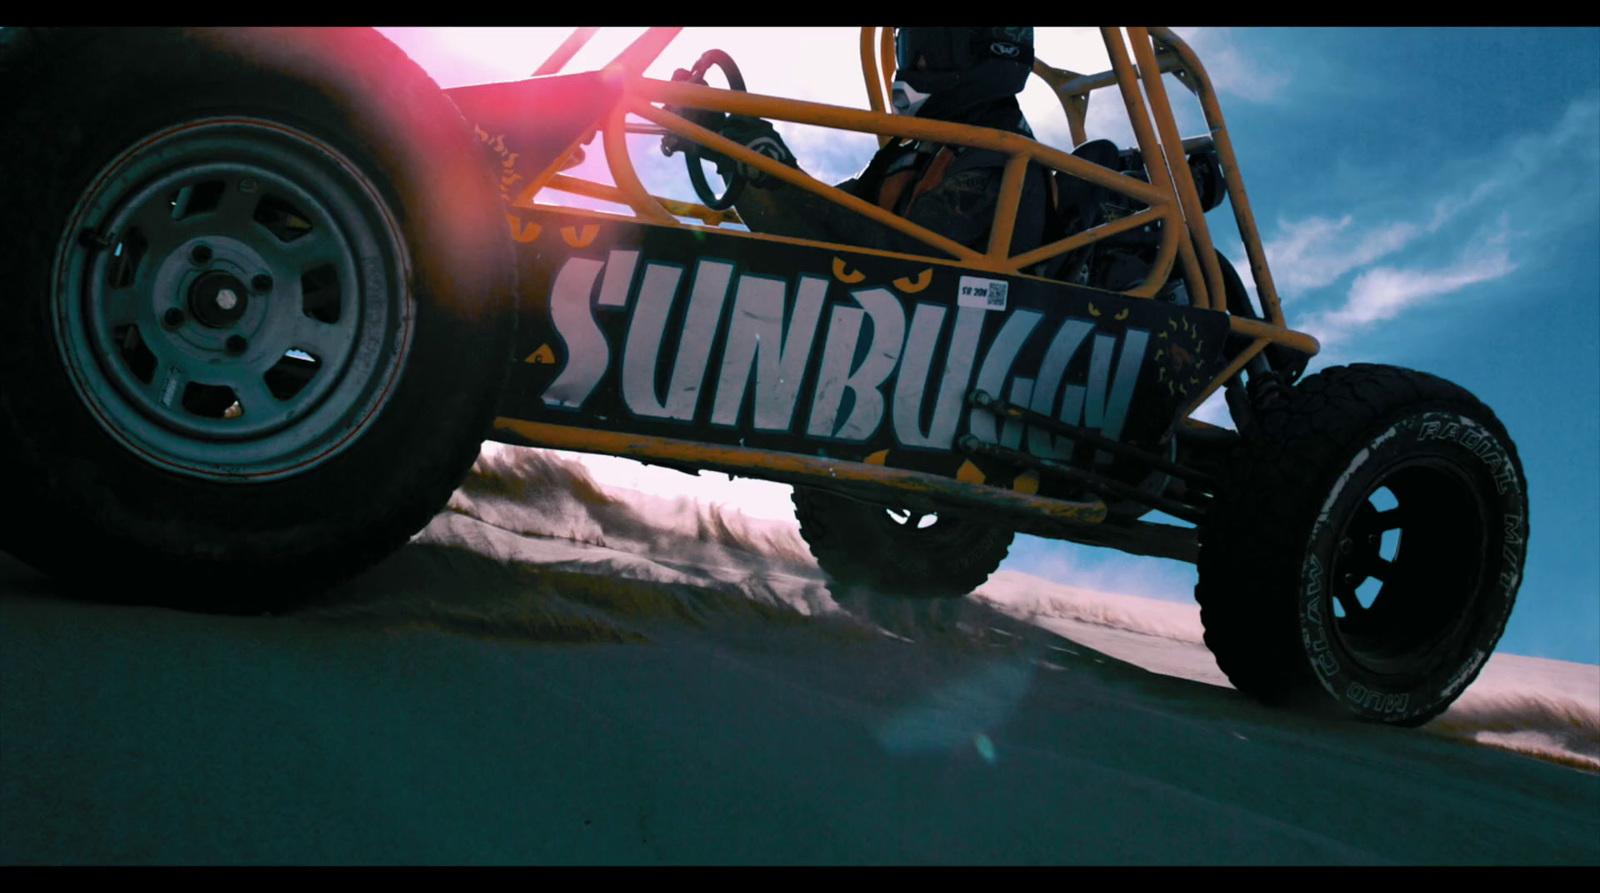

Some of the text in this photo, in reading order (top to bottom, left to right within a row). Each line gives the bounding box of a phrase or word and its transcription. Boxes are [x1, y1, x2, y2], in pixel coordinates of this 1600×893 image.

[541, 250, 1150, 463] SUNBUGGY
[1417, 419, 1518, 495] RADIAL
[1346, 682, 1409, 713] MUD
